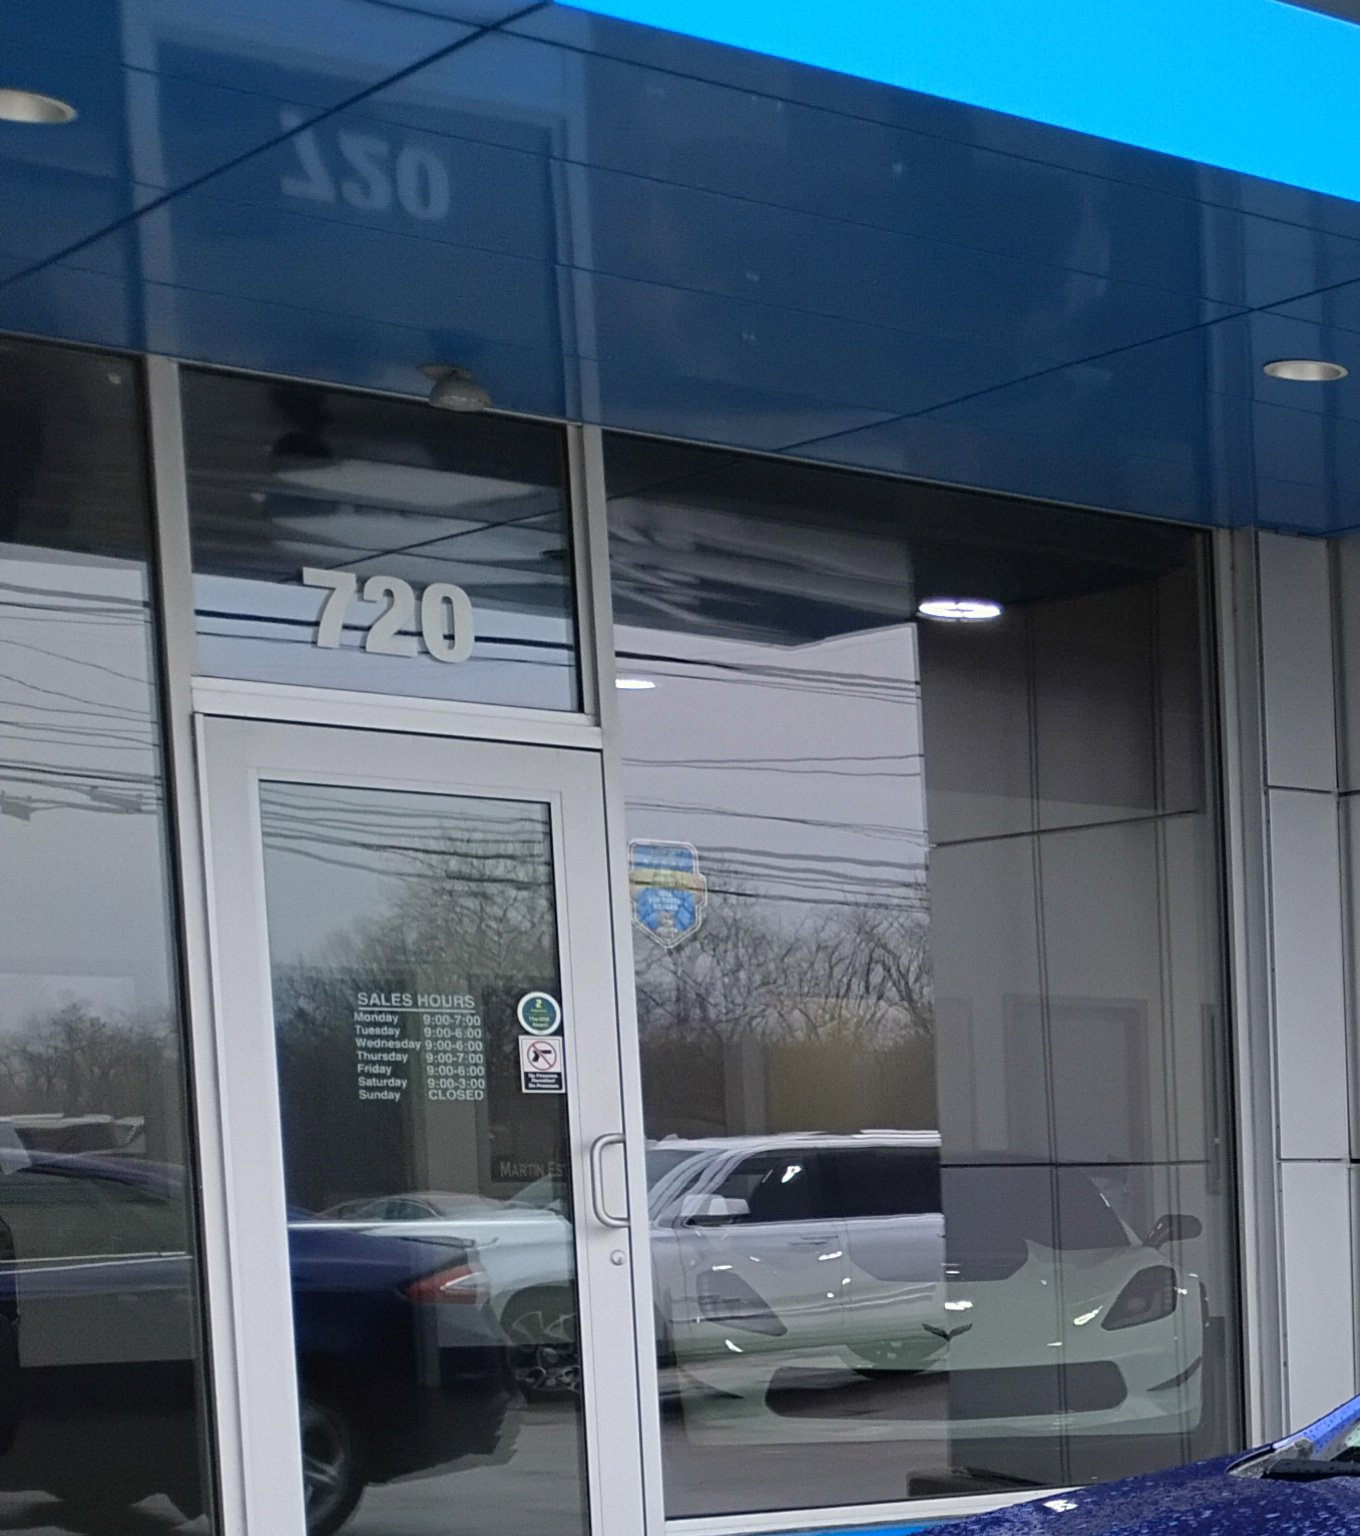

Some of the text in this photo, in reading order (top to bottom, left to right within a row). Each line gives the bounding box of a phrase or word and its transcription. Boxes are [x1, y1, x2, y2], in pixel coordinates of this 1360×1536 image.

[302, 566, 476, 666] 720
[357, 993, 475, 1009] SALES HOURS
[353, 1012, 399, 1026] Monday
[355, 1025, 400, 1037] Tuesday
[355, 1038, 422, 1050] Wednesday
[357, 1050, 409, 1064] Thursday
[357, 1064, 392, 1076] Friday
[358, 1077, 408, 1088] Saturday
[358, 1090, 484, 1102] Sunday CLOSED
